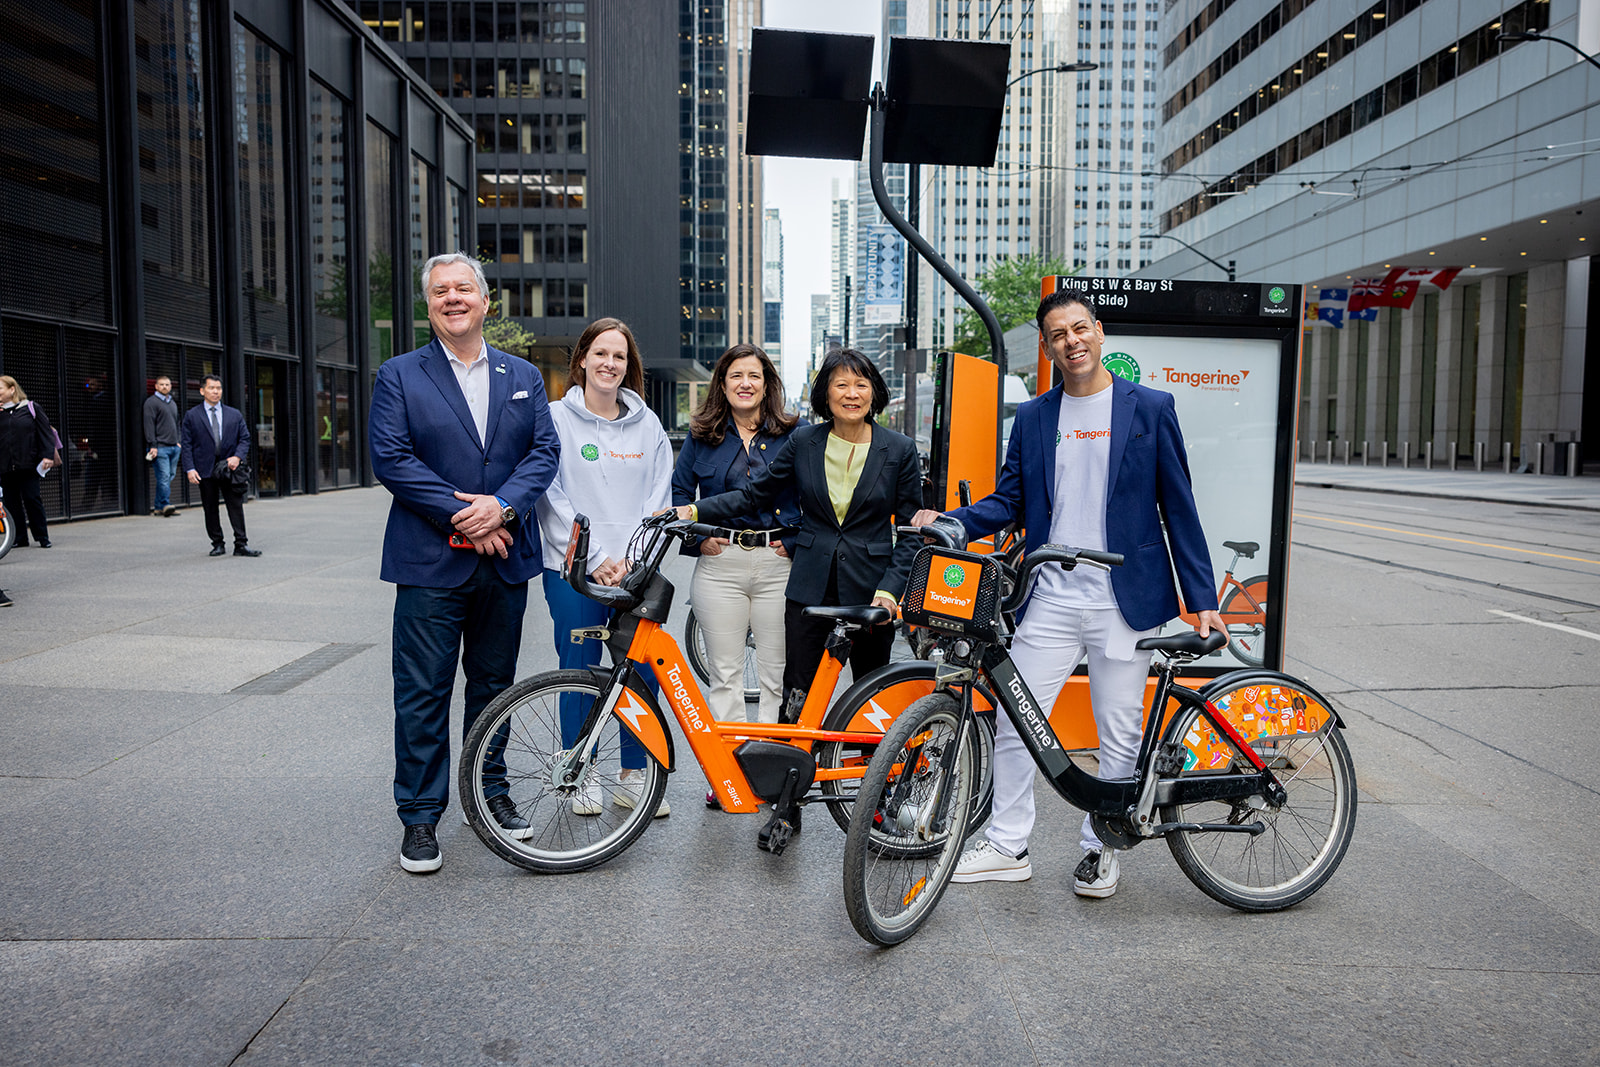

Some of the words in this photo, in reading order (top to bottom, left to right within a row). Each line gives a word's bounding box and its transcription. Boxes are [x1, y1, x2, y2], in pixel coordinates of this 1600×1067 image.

[867, 229, 878, 301] OPPORTUNITY
[1062, 277, 1088, 292] King
[1092, 278, 1105, 290] St
[1108, 279, 1119, 290] W
[1122, 279, 1131, 291] &
[1135, 279, 1157, 293] Bay
[1160, 279, 1173, 291] St
[1098, 294, 1128, 308] Side)
[1162, 367, 1241, 388] Tangerine
[1073, 428, 1111, 440] Tangeri
[930, 590, 967, 606] Tangerine
[667, 663, 703, 730] Tangerine
[1008, 672, 1051, 747] Tangerine
[723, 779, 743, 807] E-BIKE
